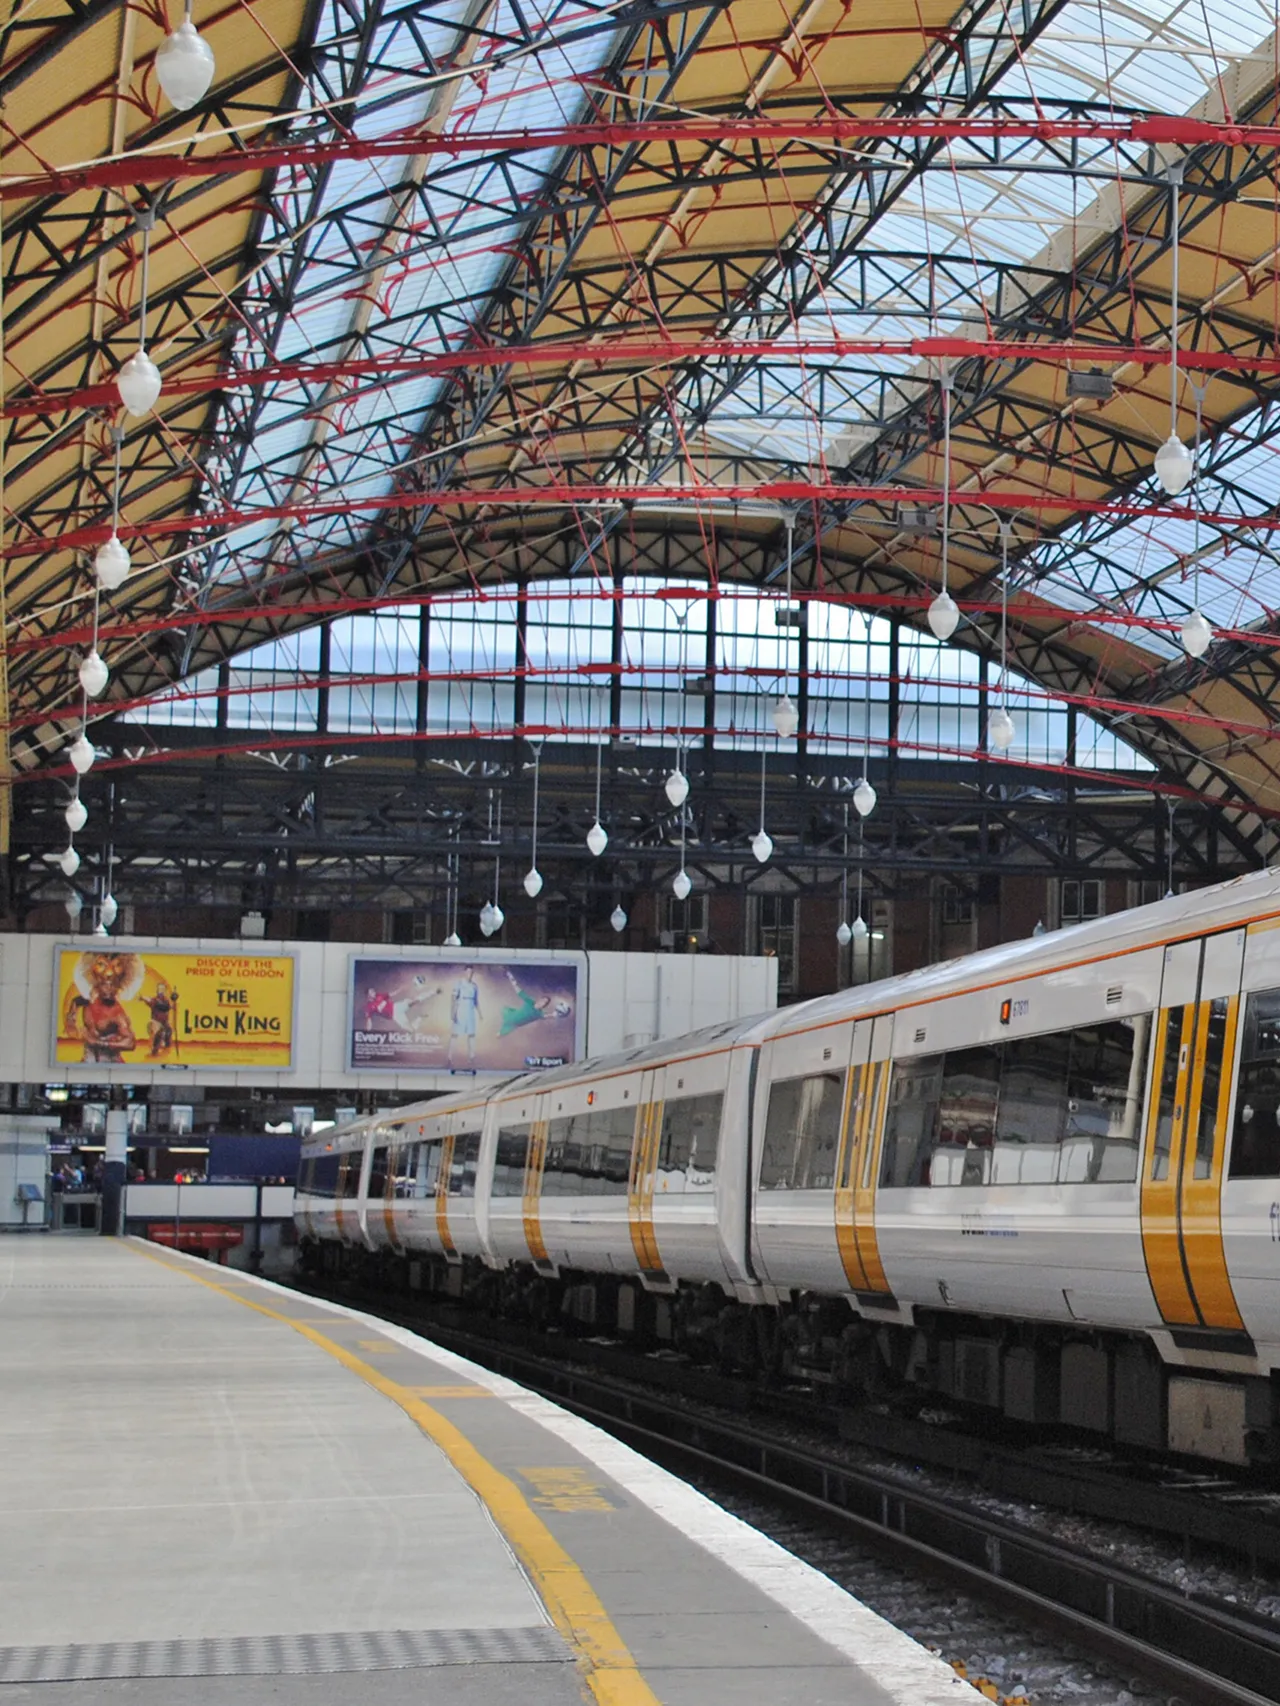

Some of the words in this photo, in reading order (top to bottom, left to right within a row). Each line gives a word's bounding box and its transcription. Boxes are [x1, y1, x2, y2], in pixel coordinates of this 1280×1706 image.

[197, 958, 250, 968] DISCOVER
[254, 959, 272, 969] THE
[186, 967, 215, 977] PRIDE
[219, 968, 232, 977] OF
[237, 969, 284, 979] LONDON
[216, 989, 248, 1004] THE
[355, 1031, 386, 1045] Every
[388, 1032, 412, 1043] Kick
[415, 1033, 440, 1044] Free
